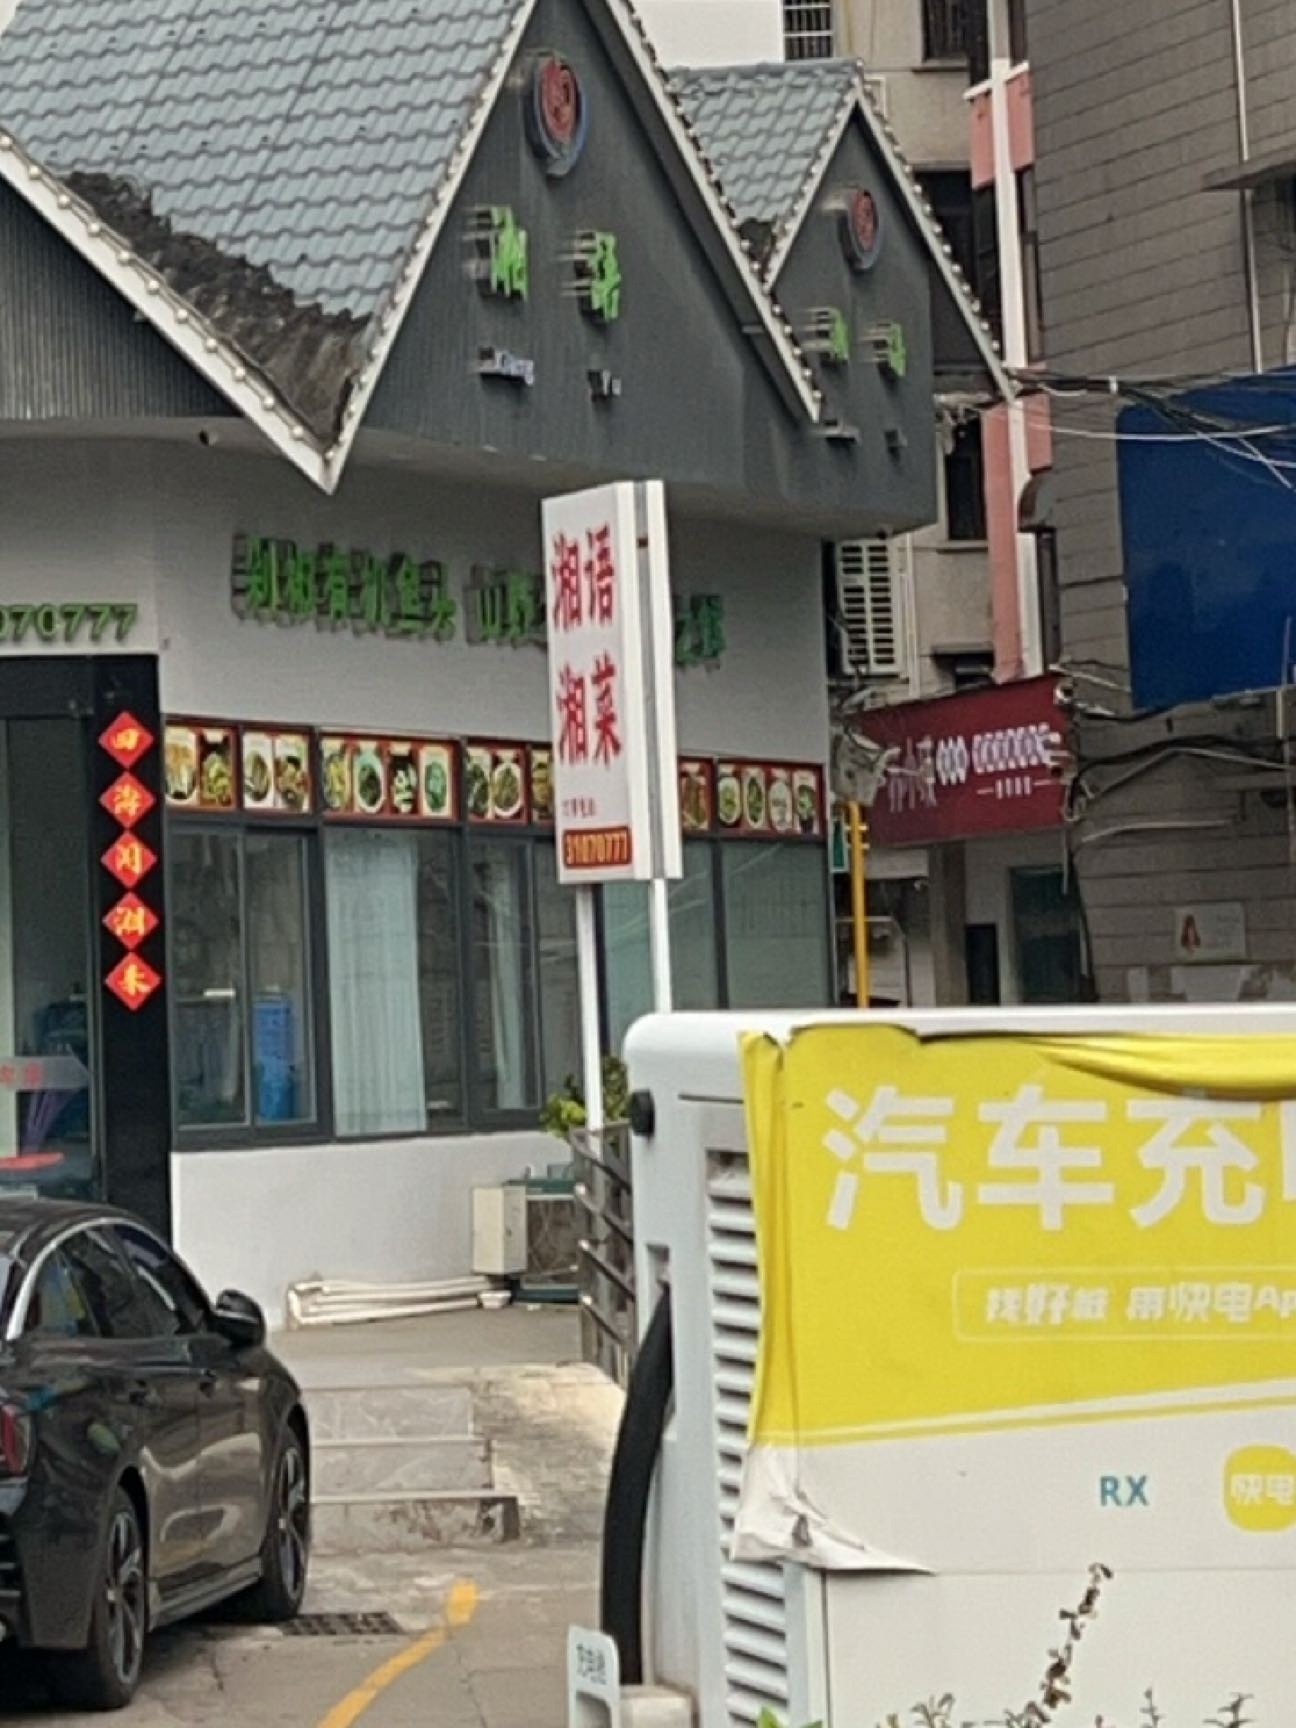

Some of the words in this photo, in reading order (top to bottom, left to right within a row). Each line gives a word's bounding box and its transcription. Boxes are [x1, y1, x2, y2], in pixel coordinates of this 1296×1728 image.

[821, 1084, 1296, 1230] 汽车充
[1099, 1474, 1150, 1507] RX
